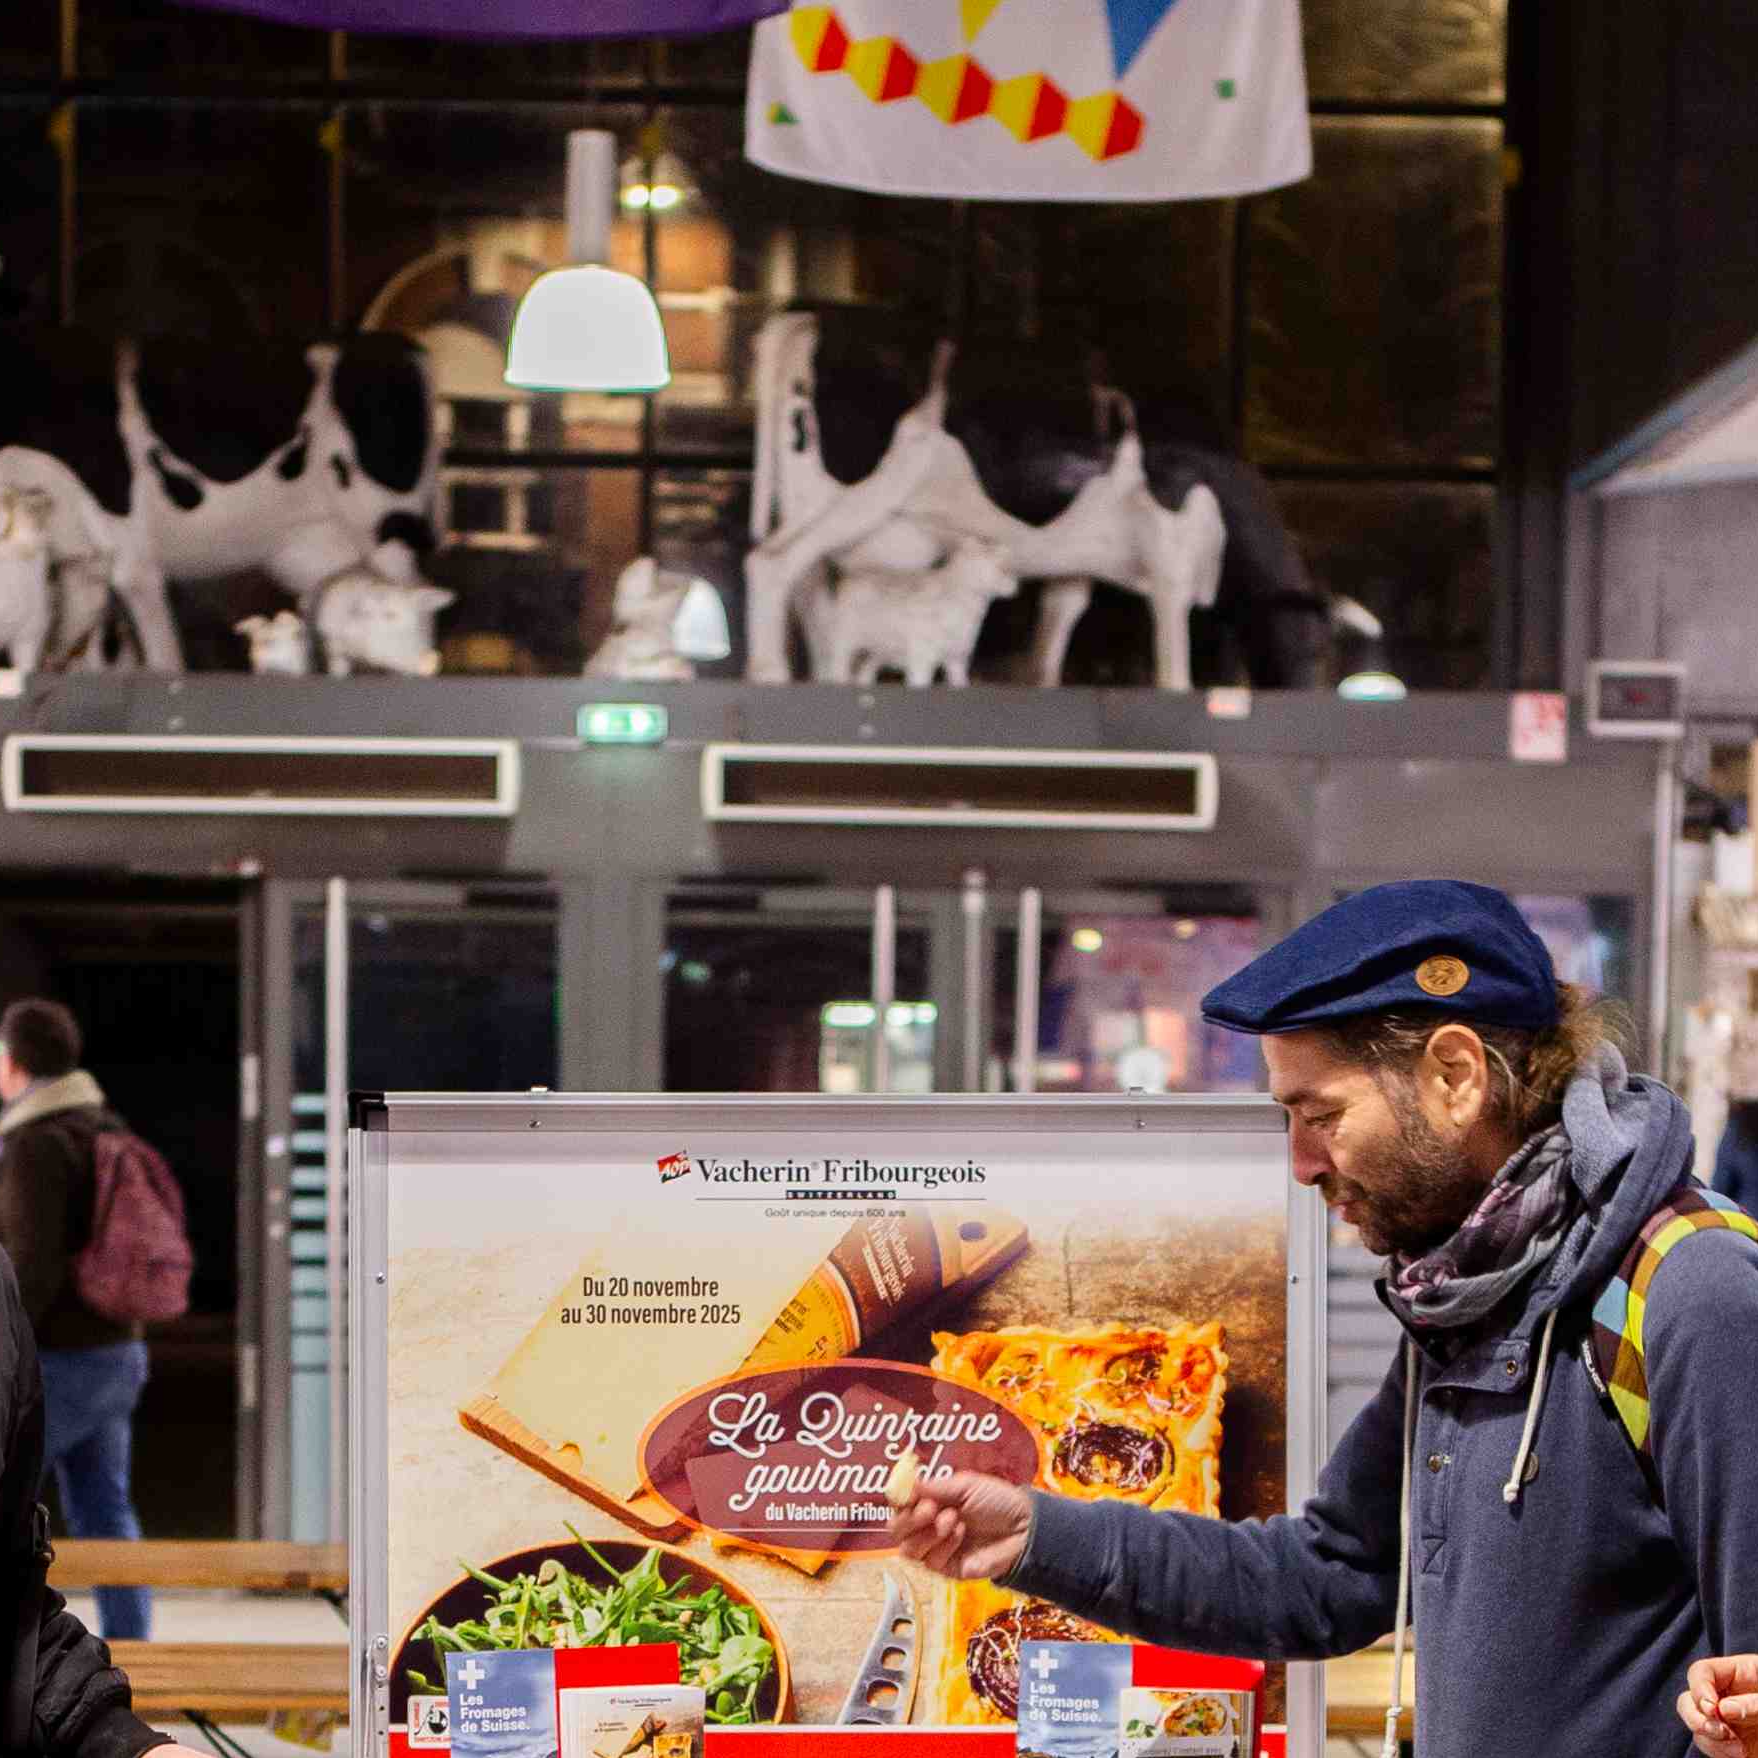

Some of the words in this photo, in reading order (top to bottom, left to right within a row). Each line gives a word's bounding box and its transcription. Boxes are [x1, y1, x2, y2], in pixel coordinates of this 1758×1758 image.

[823, 1158, 987, 1189] Fribourgeois
[583, 1277, 605, 1297] Du
[609, 1277, 629, 1297] 20
[633, 1277, 720, 1297] novembre
[561, 1307, 582, 1324] au
[586, 1304, 607, 1324] 30
[611, 1304, 697, 1324] novembre
[700, 1304, 741, 1324] 2025
[707, 1391, 785, 1459] La
[795, 1391, 1003, 1460] Quinzaine
[765, 1501, 784, 1521] du
[786, 1501, 848, 1521] Vacherin
[1030, 1682, 1056, 1695] Les
[460, 1693, 484, 1707] Les
[1029, 1695, 1100, 1711] Fromages
[460, 1706, 527, 1720] Fromages
[1029, 1709, 1048, 1722] de
[1051, 1708, 1103, 1722] Suisse.
[460, 1721, 478, 1734] de
[481, 1719, 532, 1733] Suisse.
